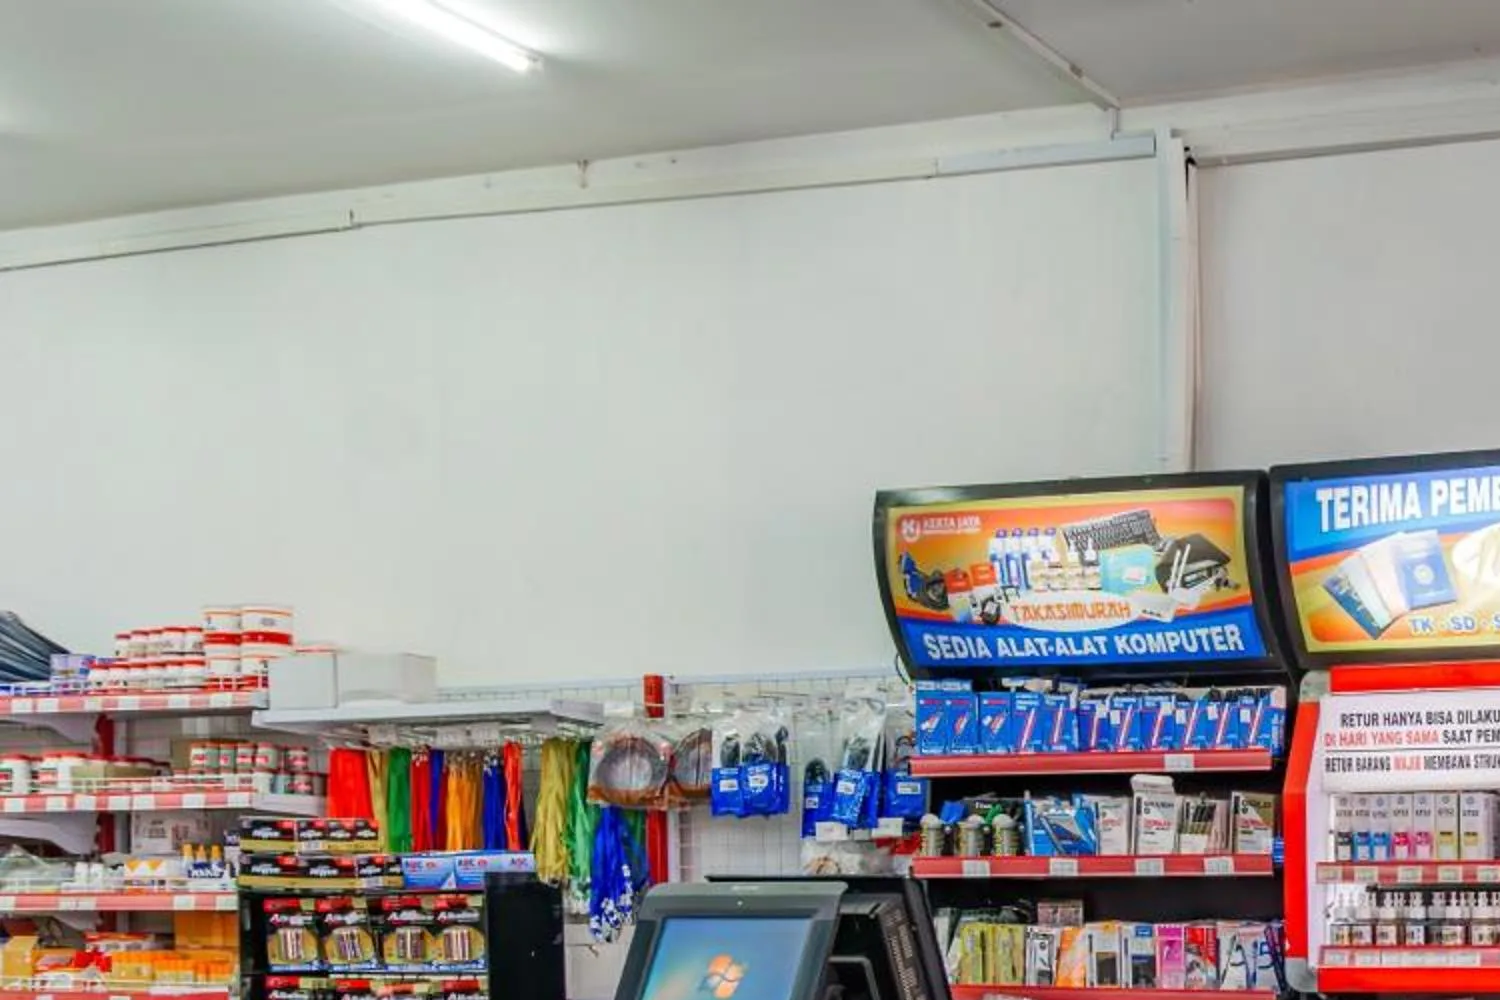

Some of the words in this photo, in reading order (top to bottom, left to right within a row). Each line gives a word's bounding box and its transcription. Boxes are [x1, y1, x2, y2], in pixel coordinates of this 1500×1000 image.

[1315, 488, 1423, 533] TERIMA
[1410, 617, 1434, 632] TK
[1450, 616, 1476, 631] SD
[922, 631, 992, 660] SEDIA
[996, 631, 1108, 660] ALAT-ALAT
[1114, 623, 1245, 654] KOMPUTER
[1340, 712, 1379, 728] RETUR
[1383, 711, 1423, 727] HANYA
[1425, 710, 1453, 726] BISA
[1324, 734, 1336, 747] DI
[1339, 732, 1368, 747] HARI
[1370, 731, 1403, 745] YANG
[1405, 730, 1440, 745] SAMA
[1442, 729, 1473, 744] SAAT
[1325, 757, 1352, 773] RETUR
[1355, 756, 1391, 772] BARANG
[1423, 754, 1471, 770] MEMBAWA
